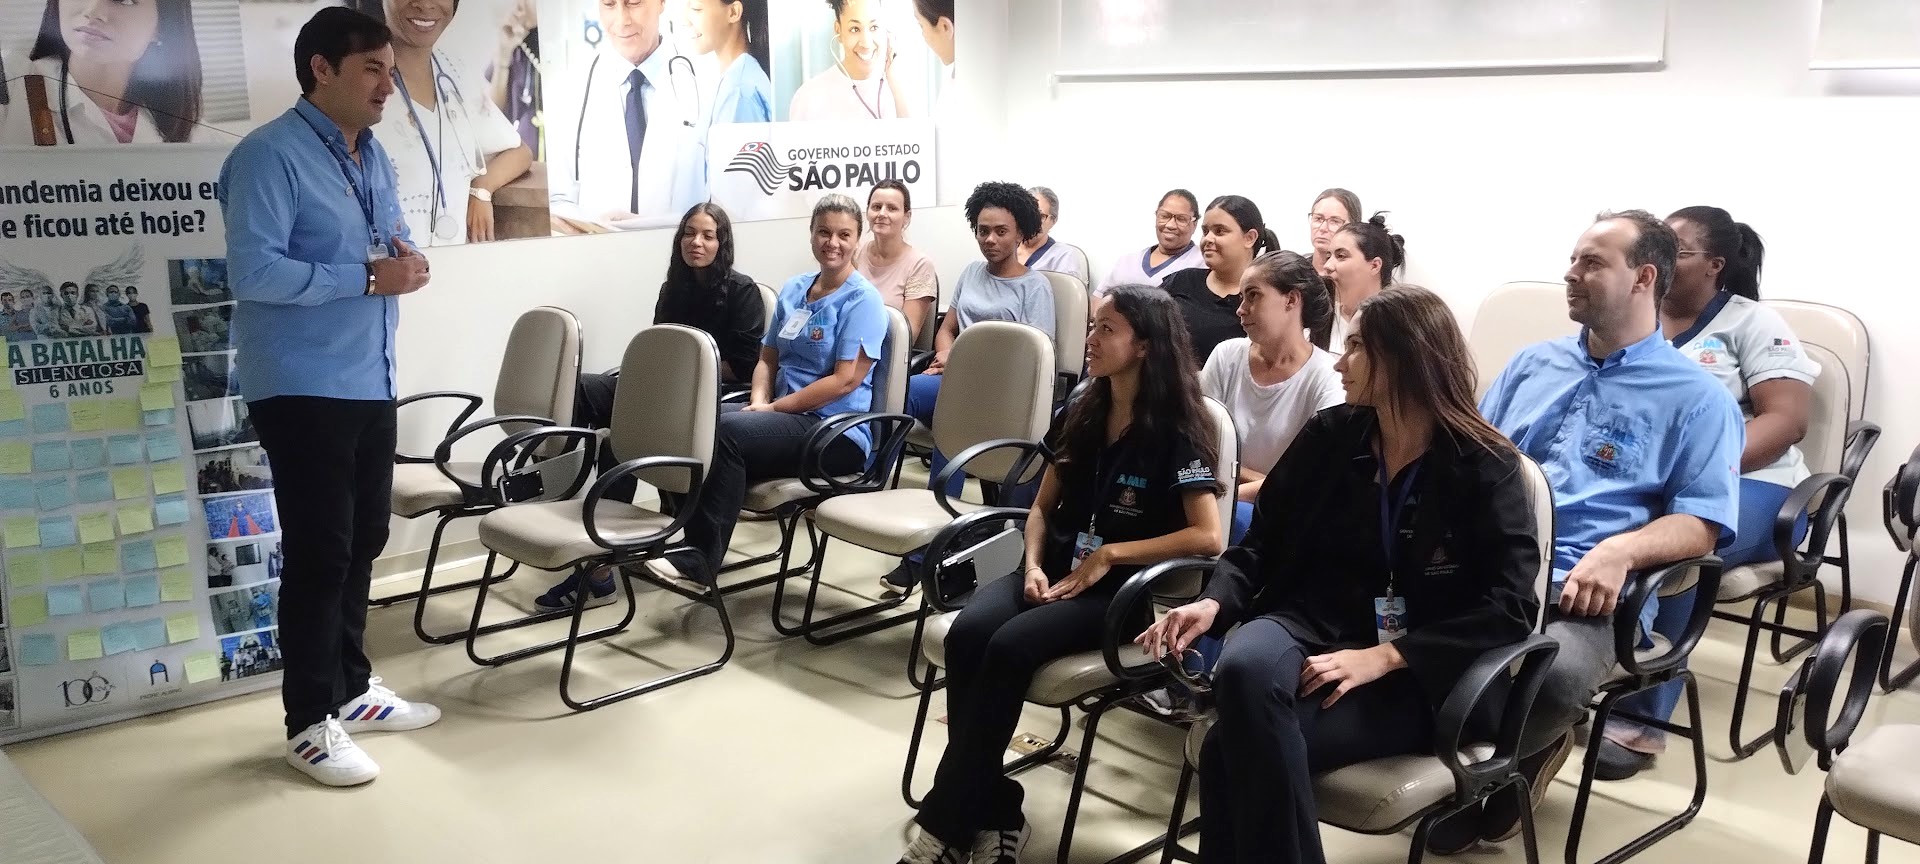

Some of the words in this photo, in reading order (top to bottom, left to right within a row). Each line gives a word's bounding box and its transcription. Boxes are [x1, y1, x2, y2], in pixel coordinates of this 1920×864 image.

[788, 147, 850, 161] GOVERNO
[853, 146, 871, 158] DO
[875, 143, 920, 157] ESTADO
[788, 160, 841, 192] SÃO
[845, 159, 921, 188] PAULO
[109, 178, 192, 203] deixou
[24, 213, 88, 238] ficou
[95, 211, 135, 236] até
[141, 209, 206, 237] hoje?
[8, 344, 26, 368] A
[31, 336, 146, 366] BATALHA
[18, 362, 141, 384] SILENCIOSA
[49, 384, 60, 399] 6
[67, 380, 114, 397] ANOS
[1116, 473, 1148, 489] AME
